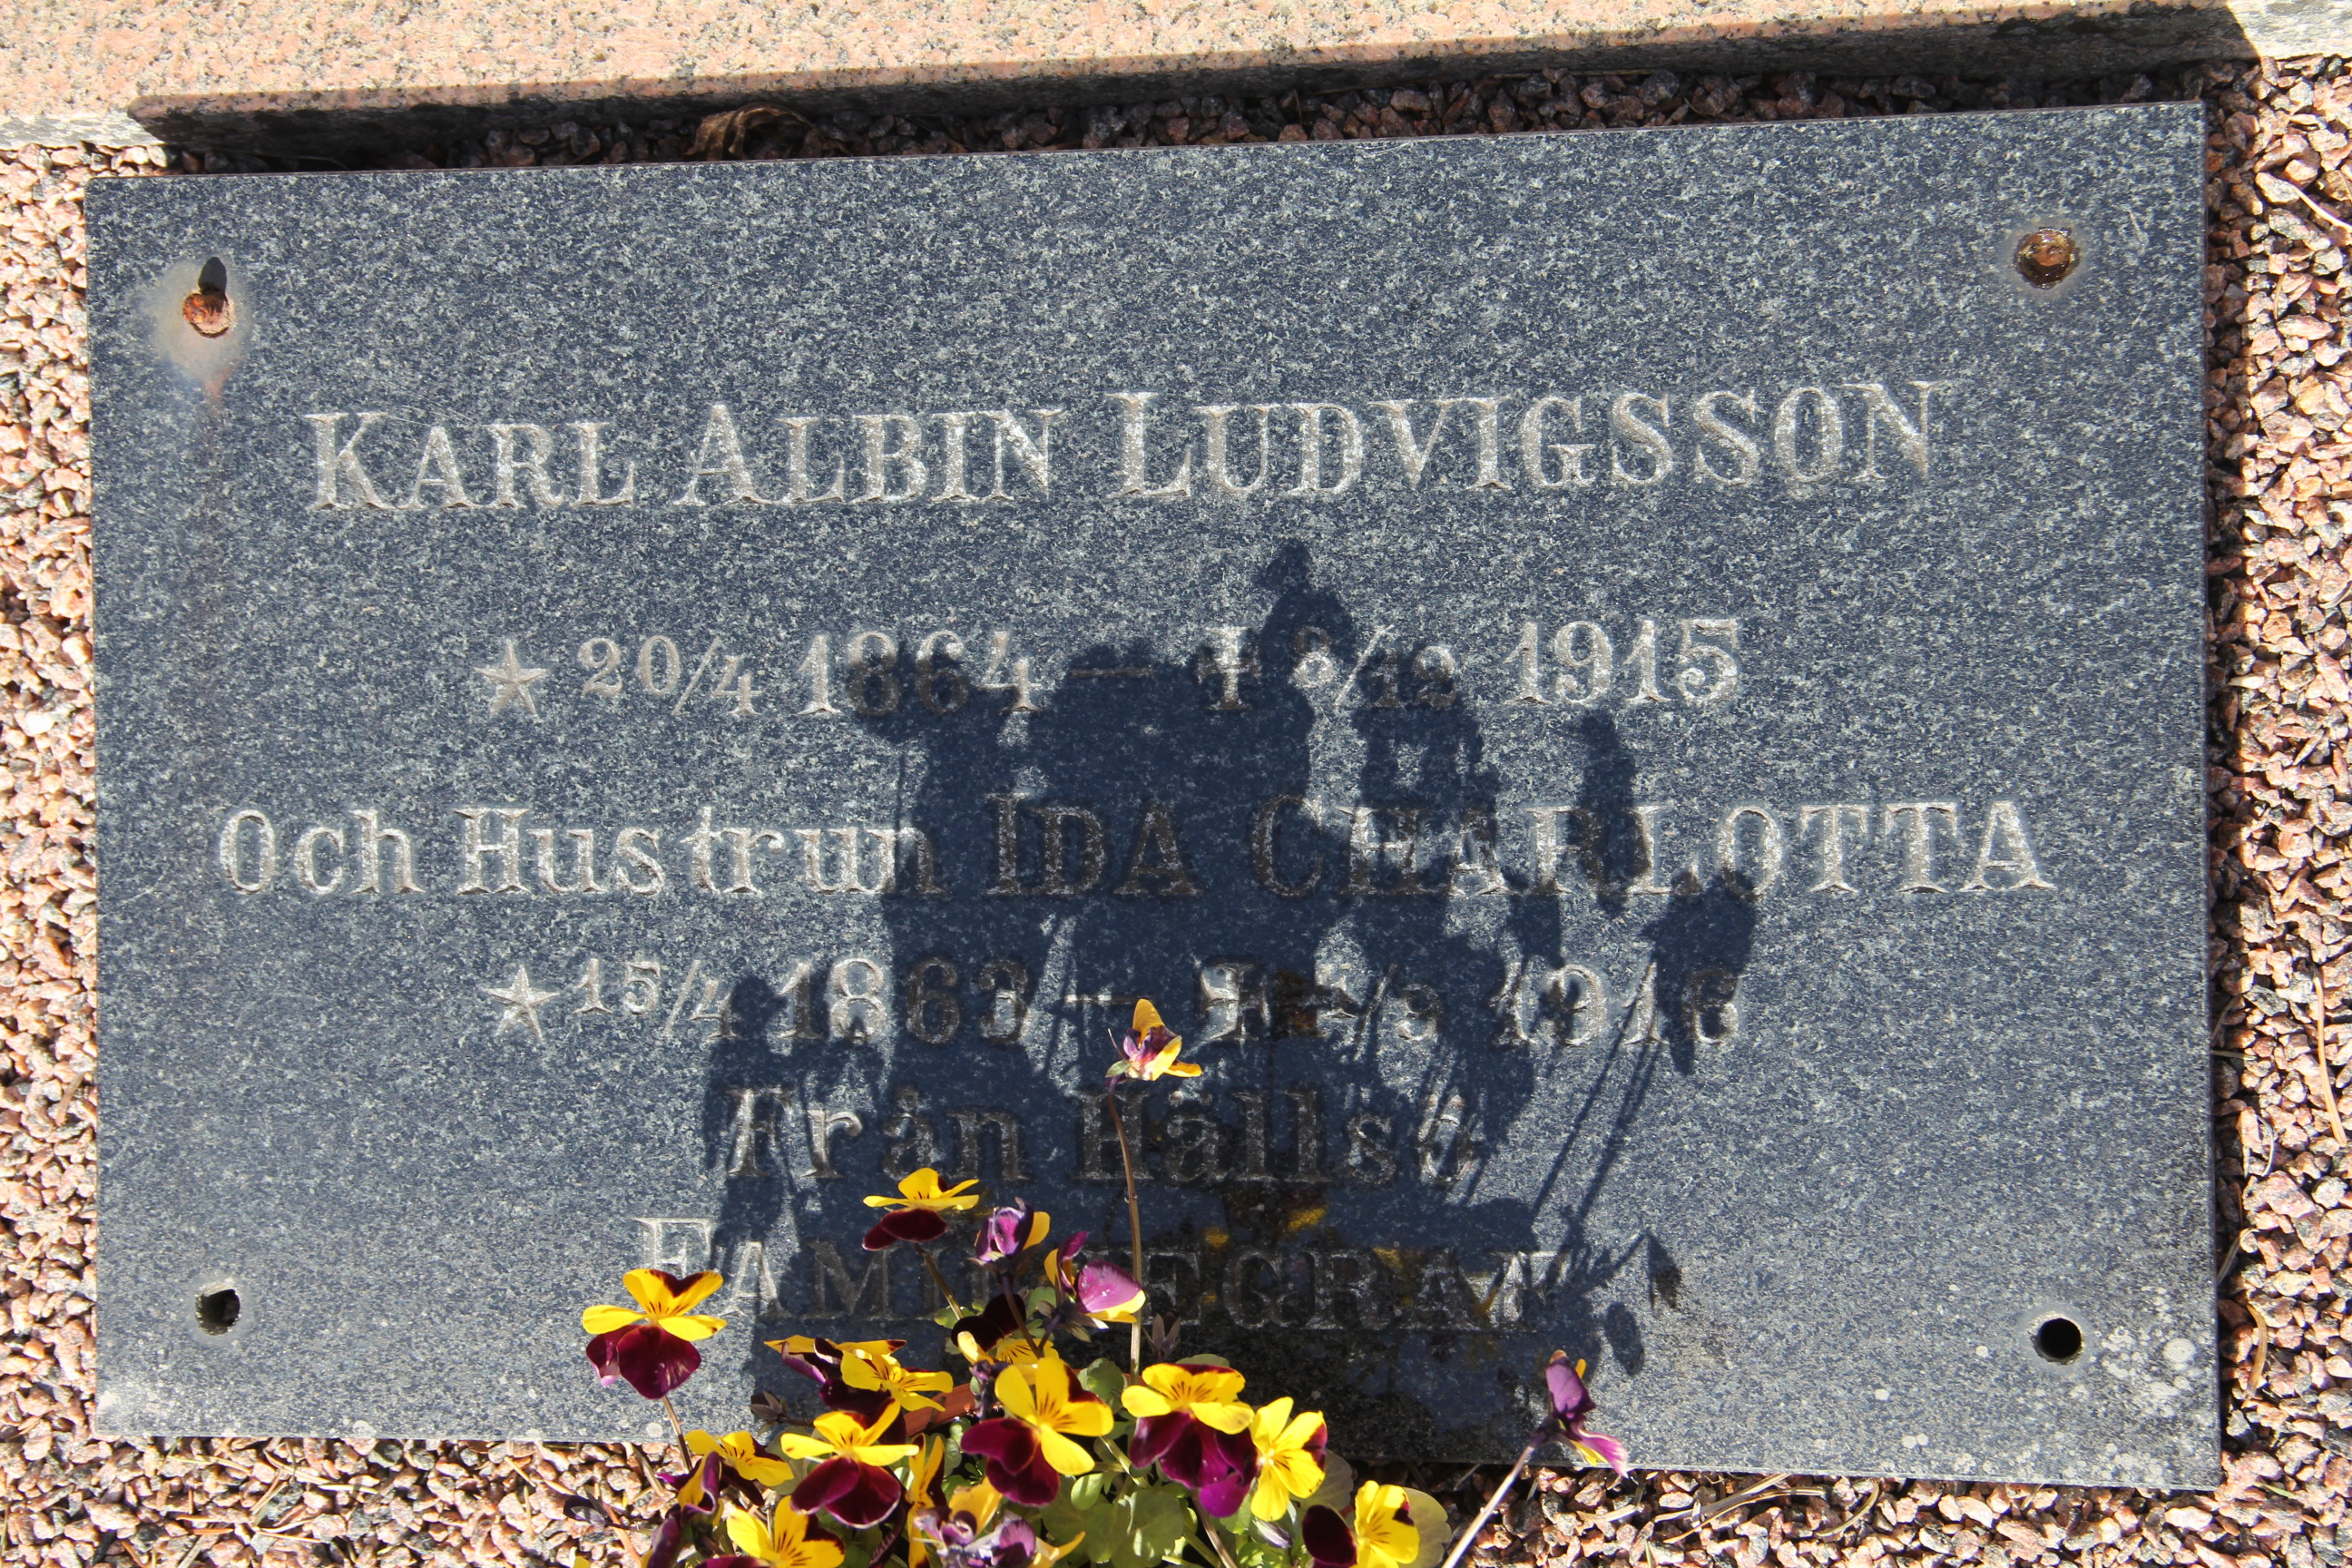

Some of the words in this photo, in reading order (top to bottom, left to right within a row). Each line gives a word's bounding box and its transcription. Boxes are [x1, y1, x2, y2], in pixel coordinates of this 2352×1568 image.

[303, 411, 635, 512] KARL
[672, 403, 1063, 508] ALBIN
[1102, 378, 1951, 499] LUDVIGSSON
[576, 633, 763, 718] 20/4
[795, 629, 1044, 717] 1864
[1290, 623, 1456, 710] 8/12
[1502, 616, 1740, 706] 1915
[218, 807, 427, 897] Och
[455, 805, 946, 898] Hustrun
[984, 789, 1205, 899] IDA
[1250, 793, 2056, 903] CHARLOTTA
[570, 957, 744, 1042] 15/4
[774, 956, 1032, 1046] 1863
[726, 1084, 1031, 1183] Från
[630, 1216, 1570, 1332] FAMIEGRAV
